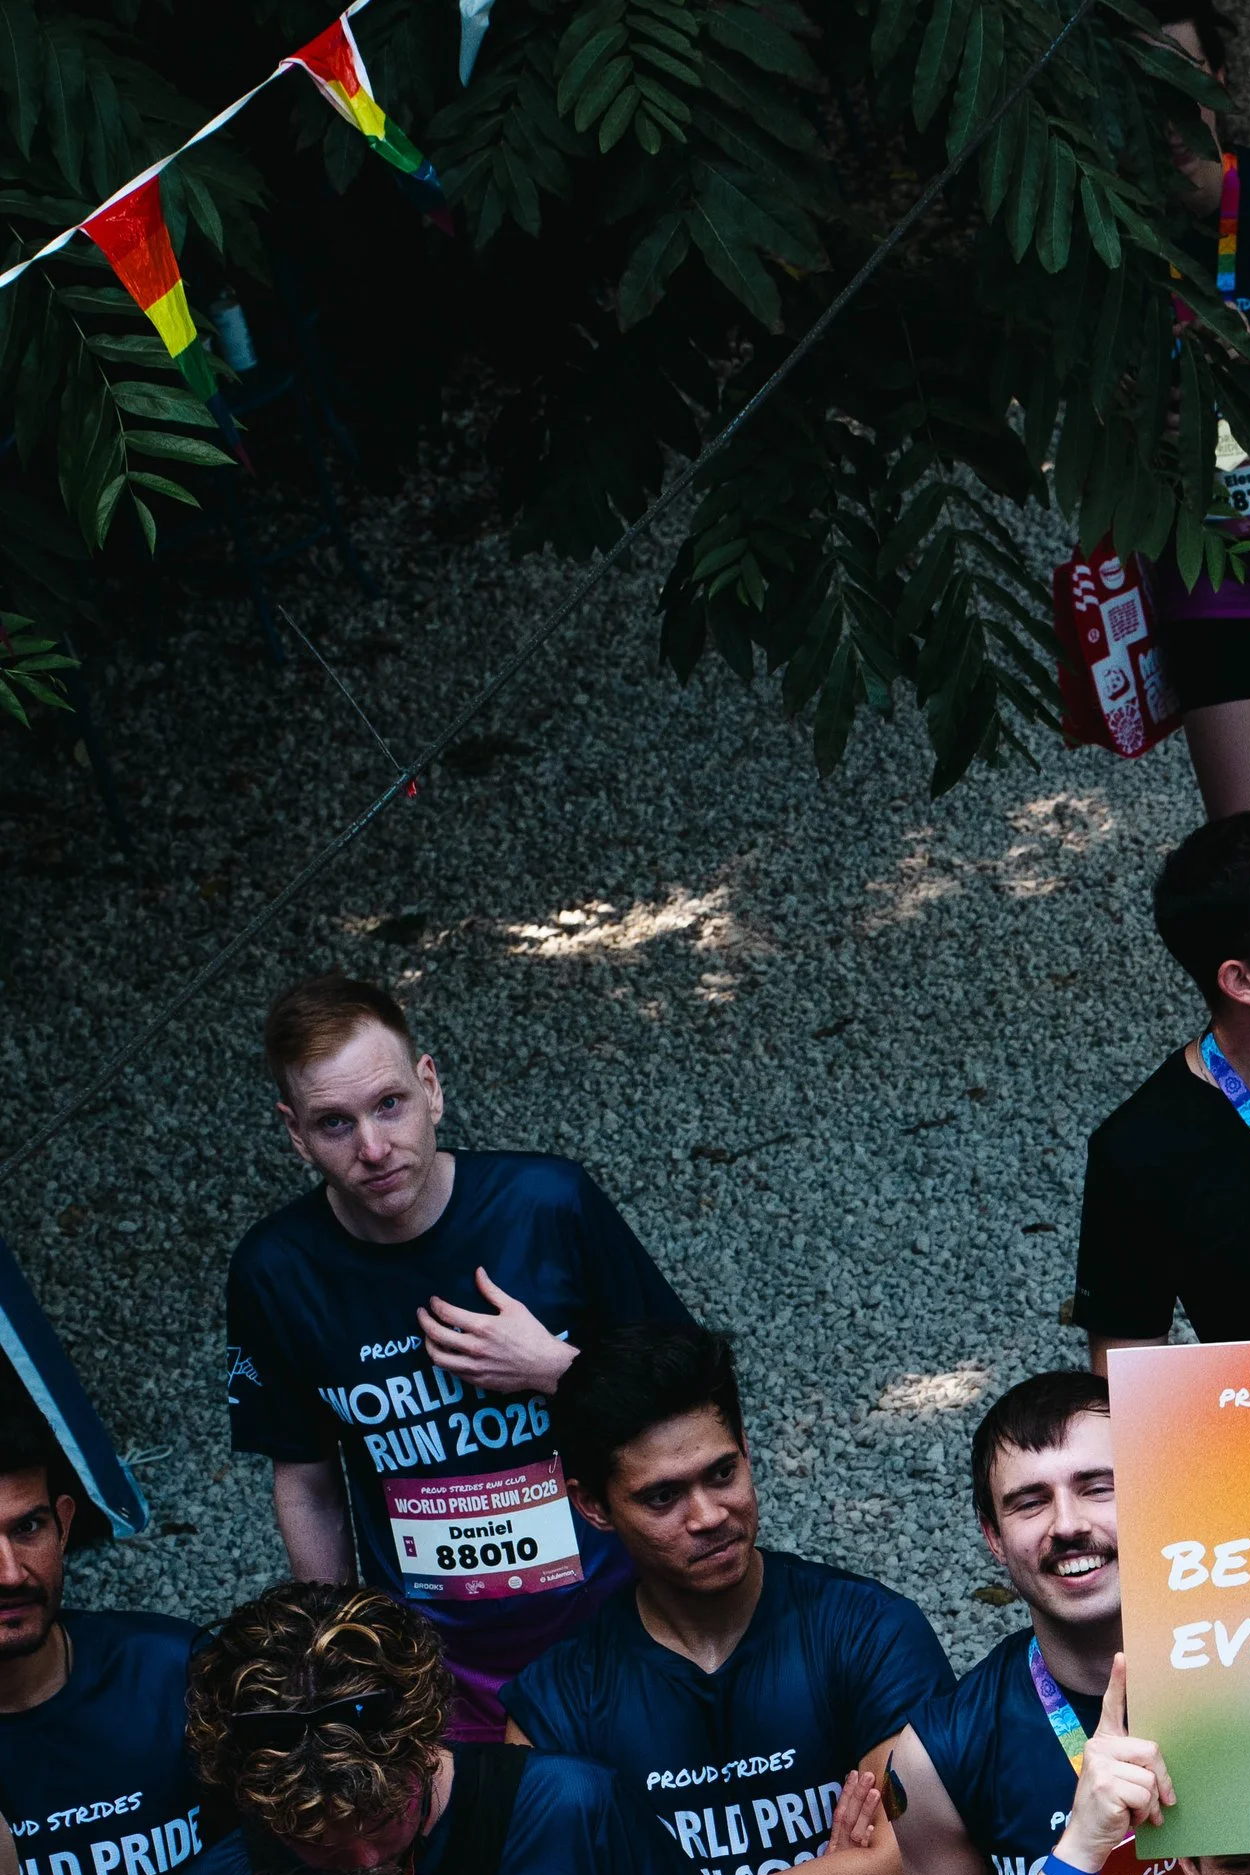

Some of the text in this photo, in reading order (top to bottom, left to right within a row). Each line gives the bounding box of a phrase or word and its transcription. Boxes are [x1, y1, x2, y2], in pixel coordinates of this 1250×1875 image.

[359, 1335, 423, 1363] PROUD
[317, 1364, 464, 1426] WORLD
[363, 1396, 551, 1474] RUN 2026
[394, 1478, 558, 1515] WORLD PRIDE RUN 2026
[421, 1475, 527, 1494] PROUD STRIDES RUN CLUB
[449, 1520, 513, 1540] Daniel
[436, 1537, 539, 1570] 88010
[413, 1582, 444, 1591] BROOKS
[646, 1748, 797, 1791] PROUD STRIDES
[46, 1791, 144, 1832] STRIDES
[751, 1780, 845, 1850] PRID
